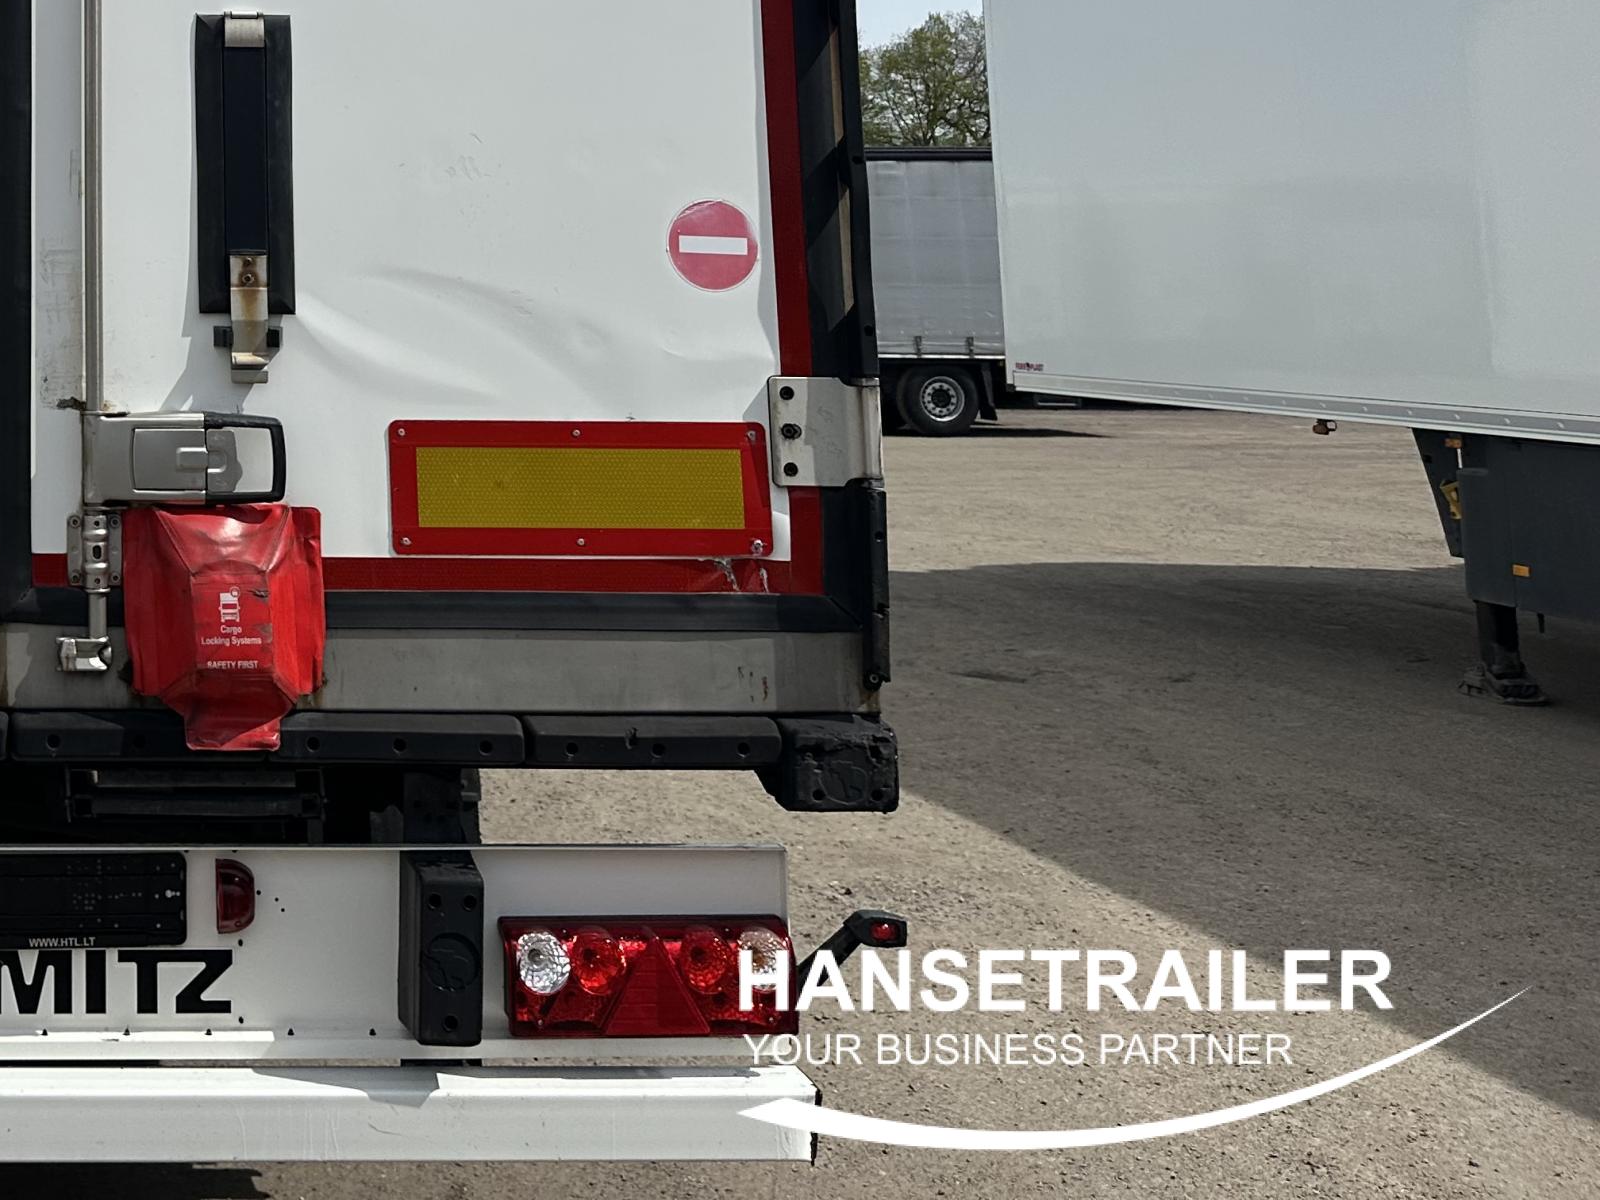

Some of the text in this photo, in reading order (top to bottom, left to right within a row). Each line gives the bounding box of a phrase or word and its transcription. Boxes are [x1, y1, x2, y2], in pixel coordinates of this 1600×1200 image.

[220, 625, 242, 635] Cargo
[201, 636, 262, 647] Locking Systems
[207, 661, 258, 669] SAFETY FIRST
[29, 936, 96, 947] WWW.HTL.LT
